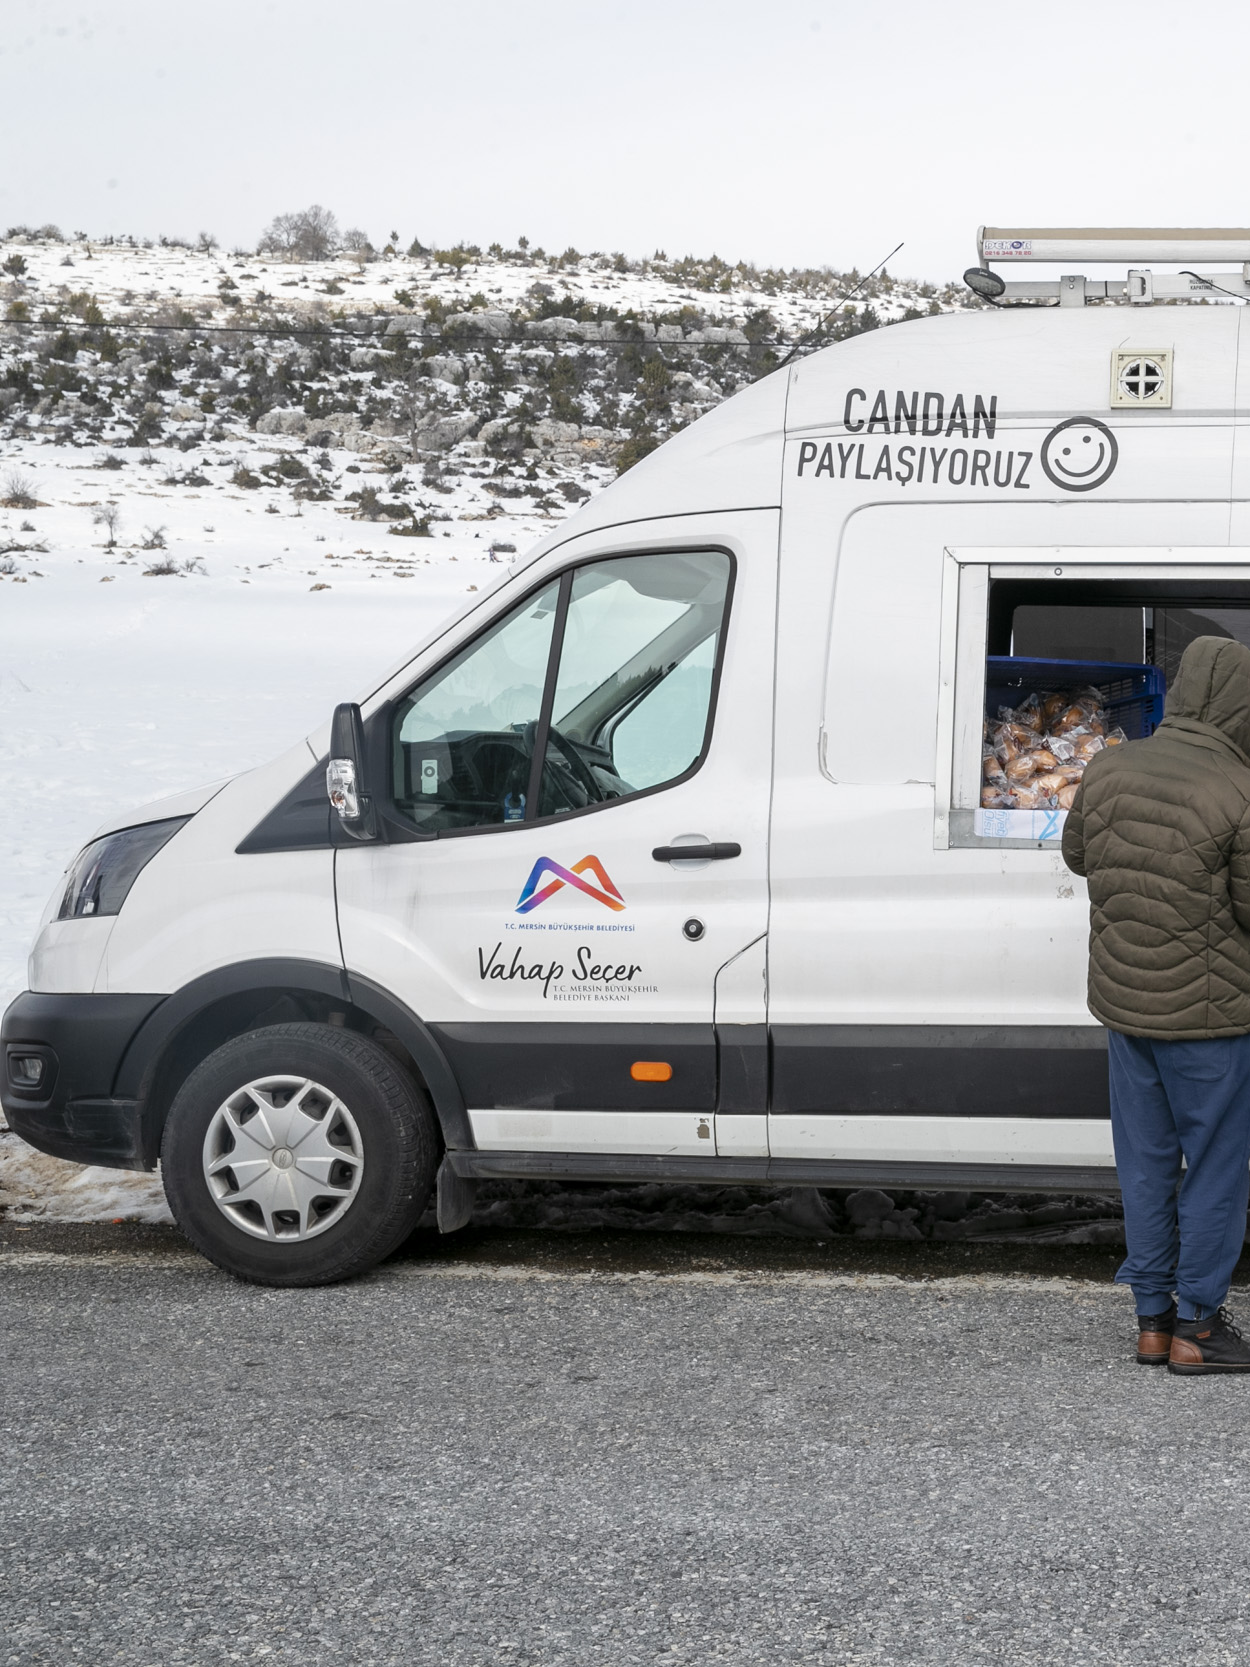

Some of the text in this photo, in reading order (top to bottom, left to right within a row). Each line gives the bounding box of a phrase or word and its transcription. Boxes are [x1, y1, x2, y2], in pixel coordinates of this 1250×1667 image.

[843, 388, 998, 440] CANDAN
[797, 441, 1034, 489] PAYLAŞIYORUZ
[518, 922, 547, 931] MERSİN
[478, 941, 643, 999] Vahap Seçer
[553, 985, 568, 993] T.C.
